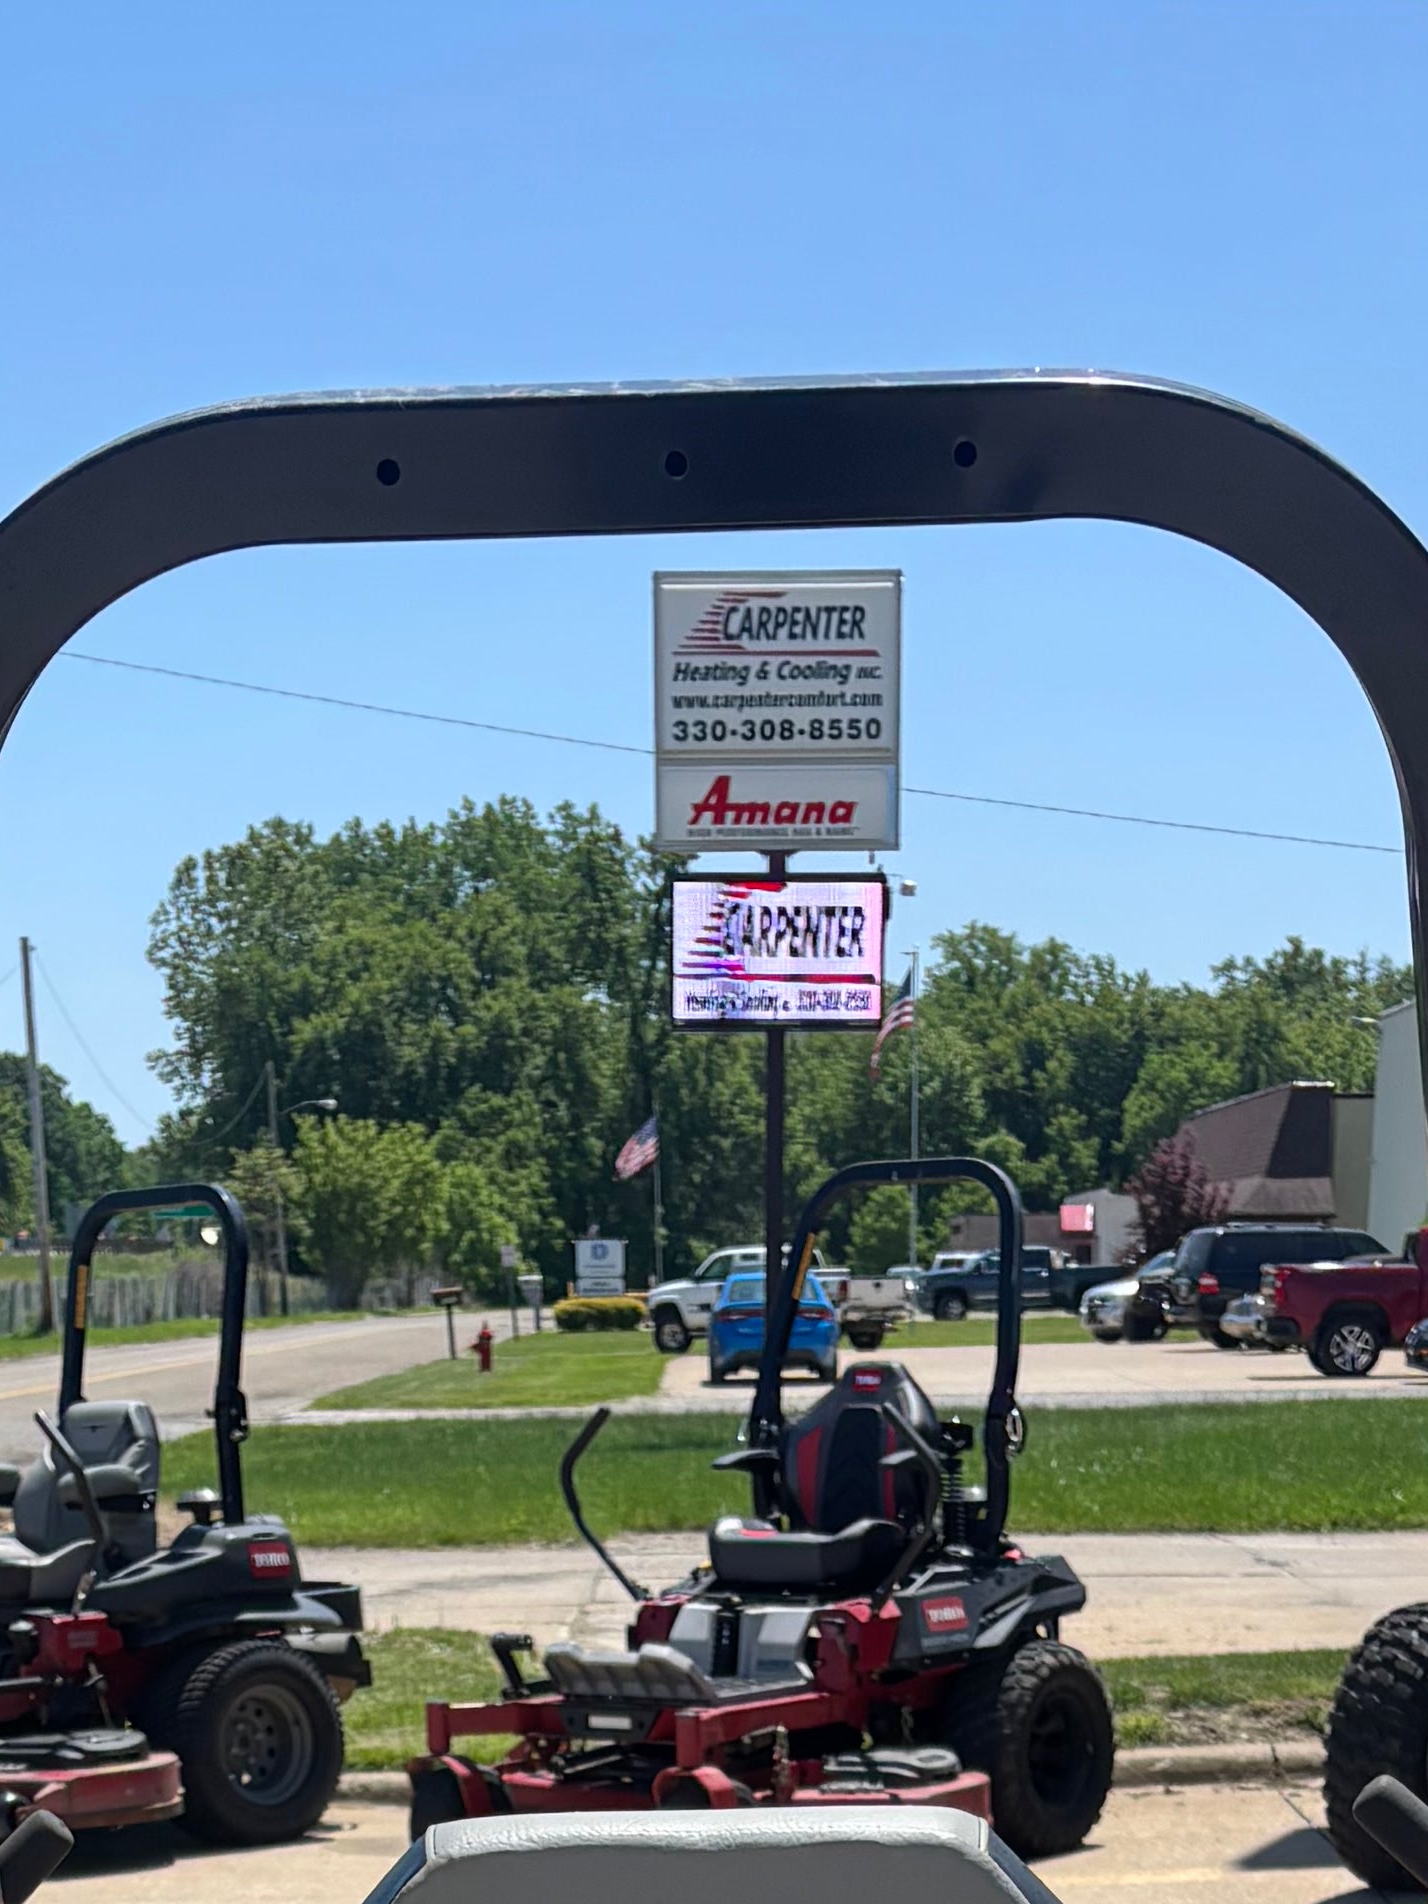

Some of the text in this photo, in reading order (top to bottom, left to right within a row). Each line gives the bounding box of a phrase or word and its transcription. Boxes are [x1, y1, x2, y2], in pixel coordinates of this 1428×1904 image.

[723, 605, 866, 641] CARPENTER
[672, 661, 751, 686] Heating
[756, 661, 771, 681] &
[776, 660, 853, 685] Cooling
[687, 775, 859, 825] Amana
[724, 902, 865, 958] CARPENTER
